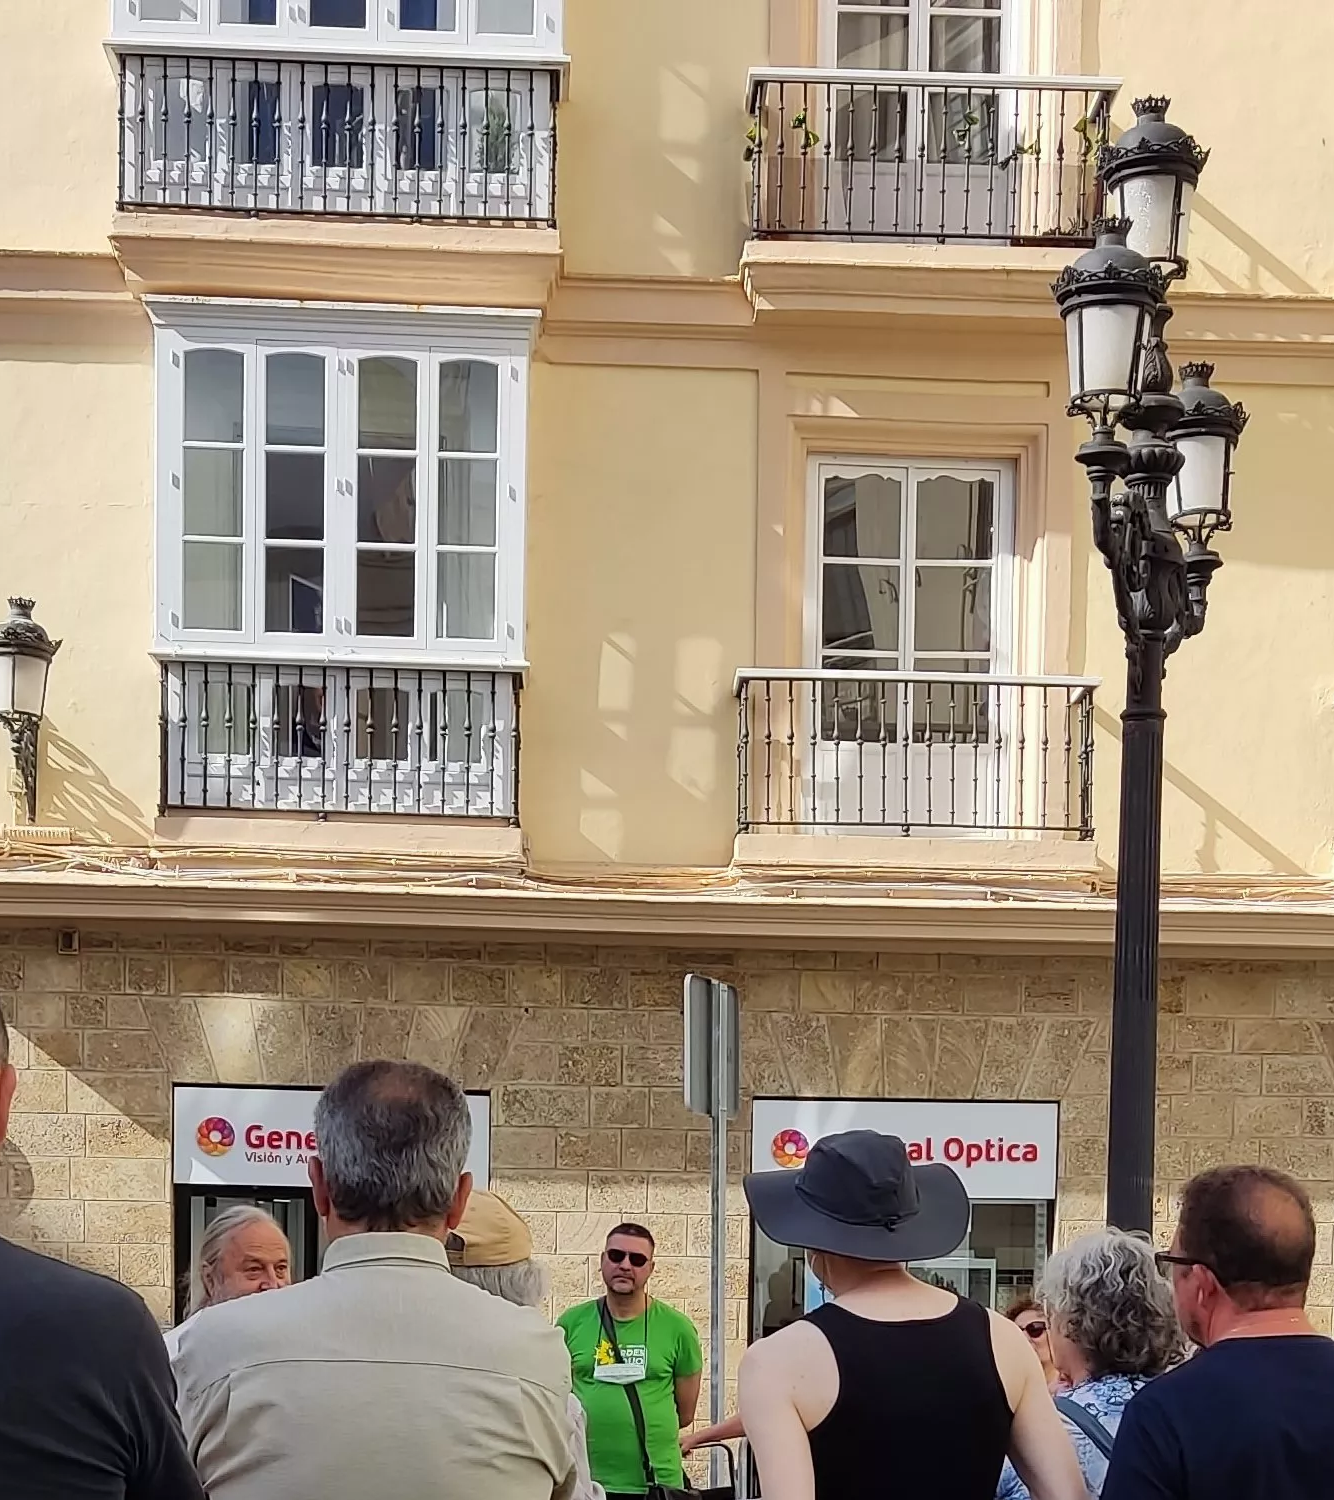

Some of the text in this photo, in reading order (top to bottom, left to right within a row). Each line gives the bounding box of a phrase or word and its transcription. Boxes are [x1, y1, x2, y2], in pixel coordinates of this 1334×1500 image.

[245, 1124, 316, 1150] Gene
[245, 1151, 282, 1163] Visión
[285, 1154, 293, 1166] y
[943, 1136, 1039, 1168] Optica
